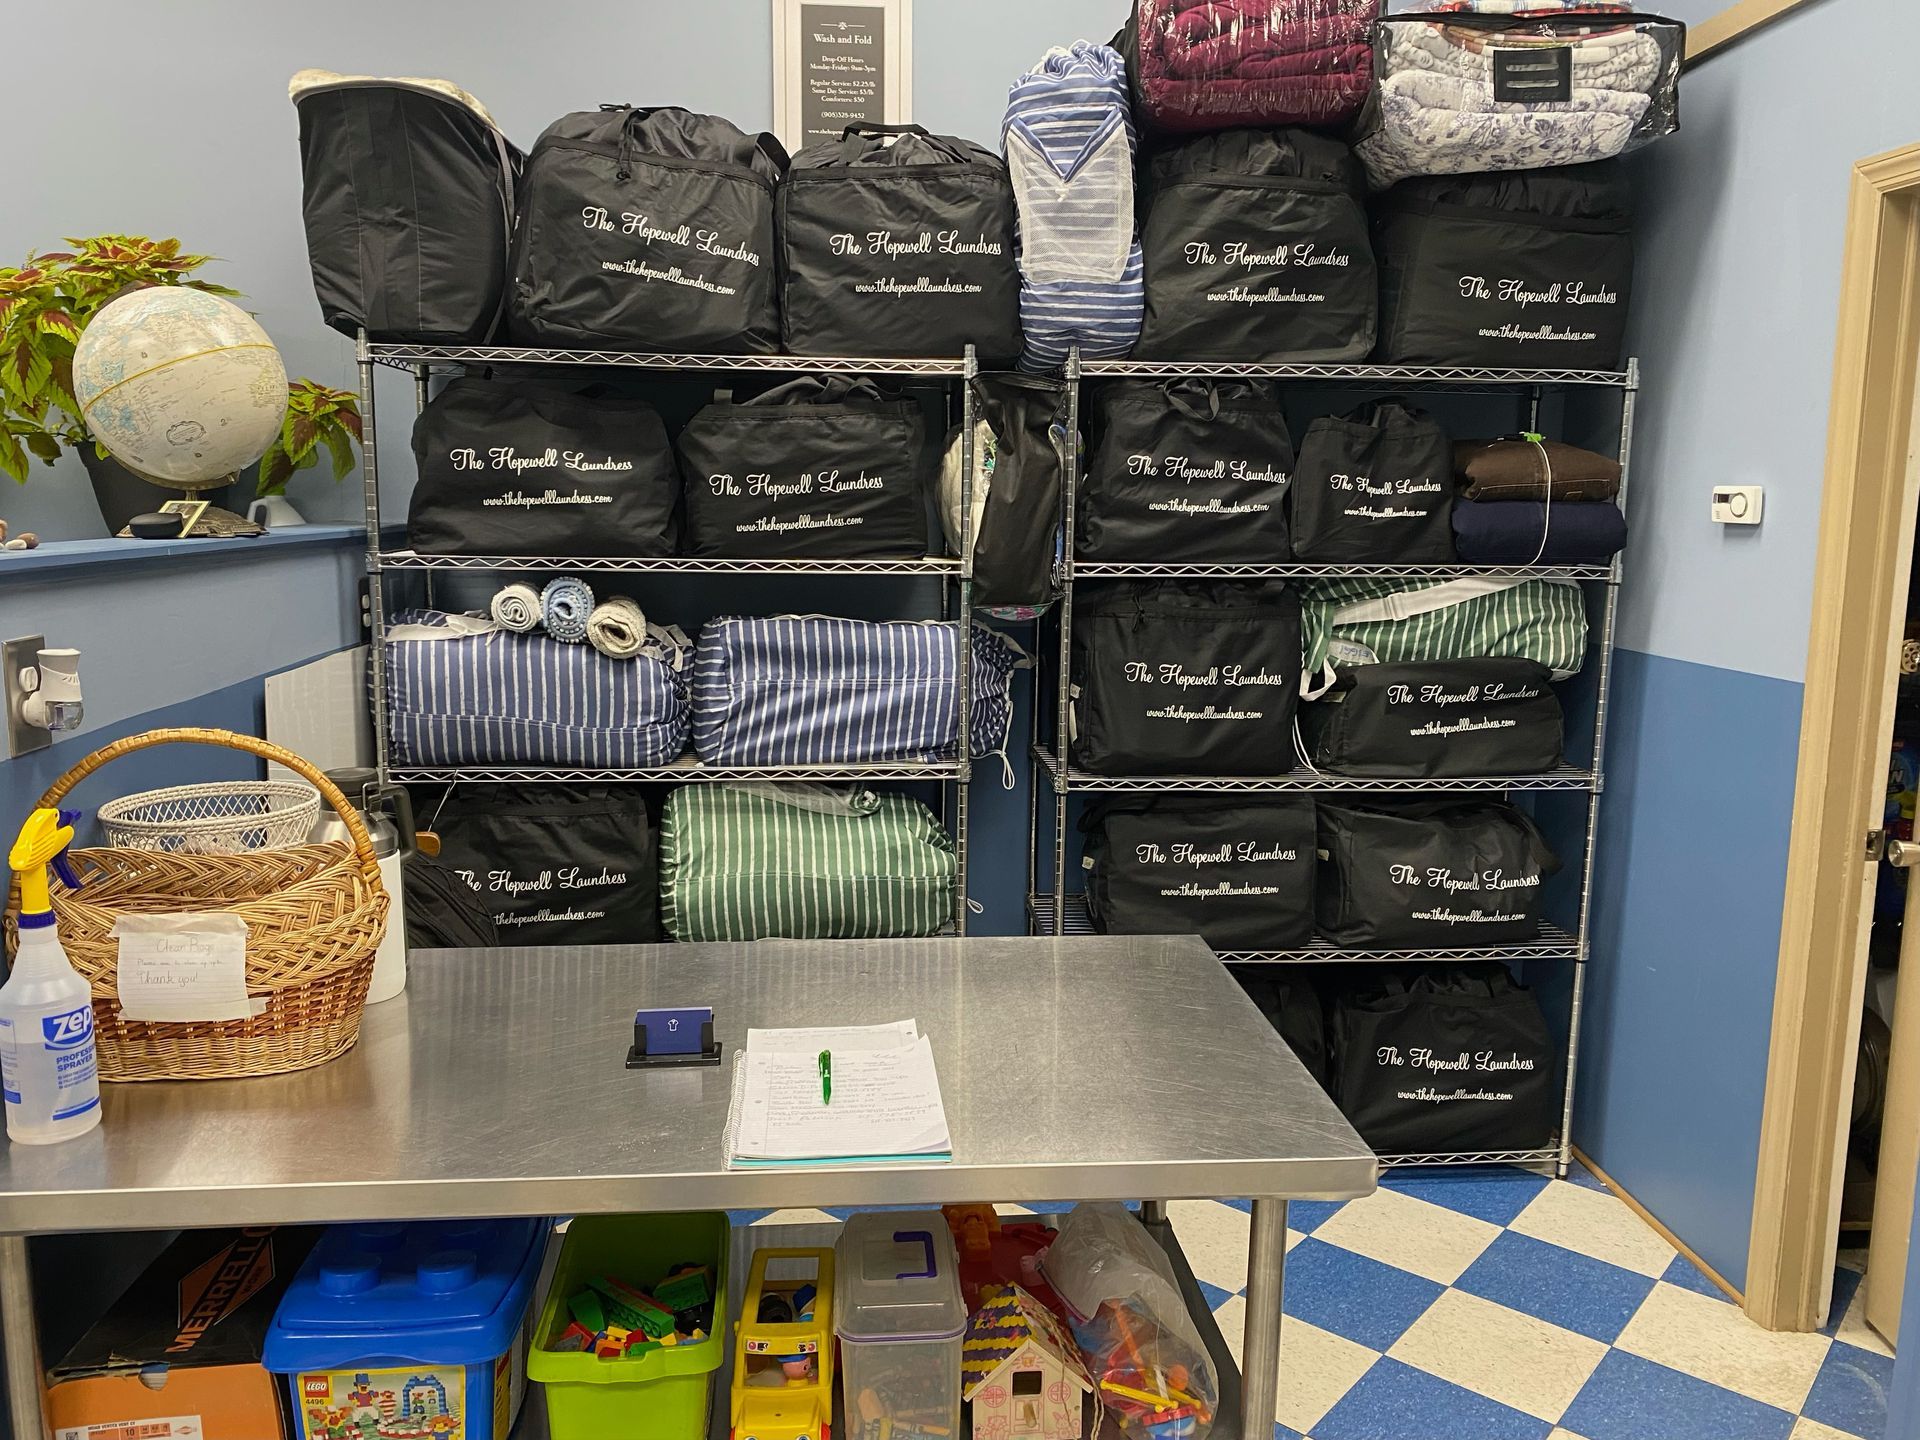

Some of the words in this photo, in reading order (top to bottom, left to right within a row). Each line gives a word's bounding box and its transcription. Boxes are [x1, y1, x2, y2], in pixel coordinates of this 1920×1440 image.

[813, 33, 836, 43] Wash
[837, 34, 852, 44] and
[854, 35, 872, 45] Fold
[822, 55, 847, 63] Drop-Off
[810, 79, 830, 87] Regular
[582, 206, 616, 232] The
[621, 212, 691, 247] Hopewell
[695, 229, 760, 267] Laundress
[829, 233, 862, 256] The
[866, 230, 932, 261] Hopewell
[936, 229, 1002, 256] Laundress
[1184, 241, 1217, 265] The
[1222, 242, 1288, 272] Hopewell
[1293, 243, 1349, 267] Laundress
[602, 259, 736, 295] www.thehopewelllaundress.com
[855, 276, 982, 298] www.thehopewelllaundress.com
[1207, 286, 1325, 307] www.thehopewelllaundress.com
[1458, 275, 1492, 300] The
[1498, 279, 1562, 309] Hopewell
[1565, 281, 1617, 305] Laundress
[1478, 323, 1597, 344] www.thehopewelllaundress.com
[449, 448, 485, 471] The
[488, 446, 559, 476] Hopewell
[562, 450, 633, 472] Laundress
[1126, 454, 1159, 476] The
[1164, 456, 1226, 485] Hopewell
[1229, 460, 1286, 484] Laundress
[708, 474, 742, 496] The
[746, 473, 813, 502] Hopewell
[817, 469, 884, 493] Laundress
[1330, 474, 1354, 491] The
[1355, 476, 1394, 498] Hopewell
[1395, 478, 1442, 494] Laundress
[483, 489, 613, 510] www.thehopewelllaundress.com
[1148, 497, 1270, 517] www.thehopewelllaundress.com
[736, 513, 864, 535] www.thehopewelllaundress.com
[1124, 661, 1154, 683] The
[1158, 663, 1218, 692] Hopewell
[1222, 664, 1282, 687] Laundress
[1387, 684, 1415, 705] The
[1420, 684, 1480, 708] Hopewell
[1482, 682, 1539, 701] Laundress
[1146, 704, 1263, 724] www.thehopewelllaundress.com
[1410, 716, 1516, 738] www.thehopewelllaundress.com
[1135, 843, 1167, 864] The
[1170, 843, 1233, 870] Hopewell
[1236, 840, 1296, 862] Laundress
[487, 869, 553, 898] Hopewell
[557, 866, 627, 889] Laundress
[1389, 864, 1422, 886] The
[1160, 881, 1279, 901] www.thehopewelllaundress.com
[1411, 906, 1526, 926] www.thehopewelllaundress.com
[136, 970, 174, 984] Thank
[178, 971, 198, 987] you!
[57, 1053, 93, 1072] SPRAYER
[1376, 1046, 1405, 1066] The
[1409, 1047, 1470, 1075] Hopewell
[1474, 1050, 1534, 1072] Laundress
[1397, 1087, 1514, 1104] www.thehopewelllaundress.com
[164, 1238, 265, 1353] MERRELL
[306, 1381, 327, 1391] LEGO
[305, 1398, 324, 1406] 4496
[126, 1428, 135, 1436] 10
